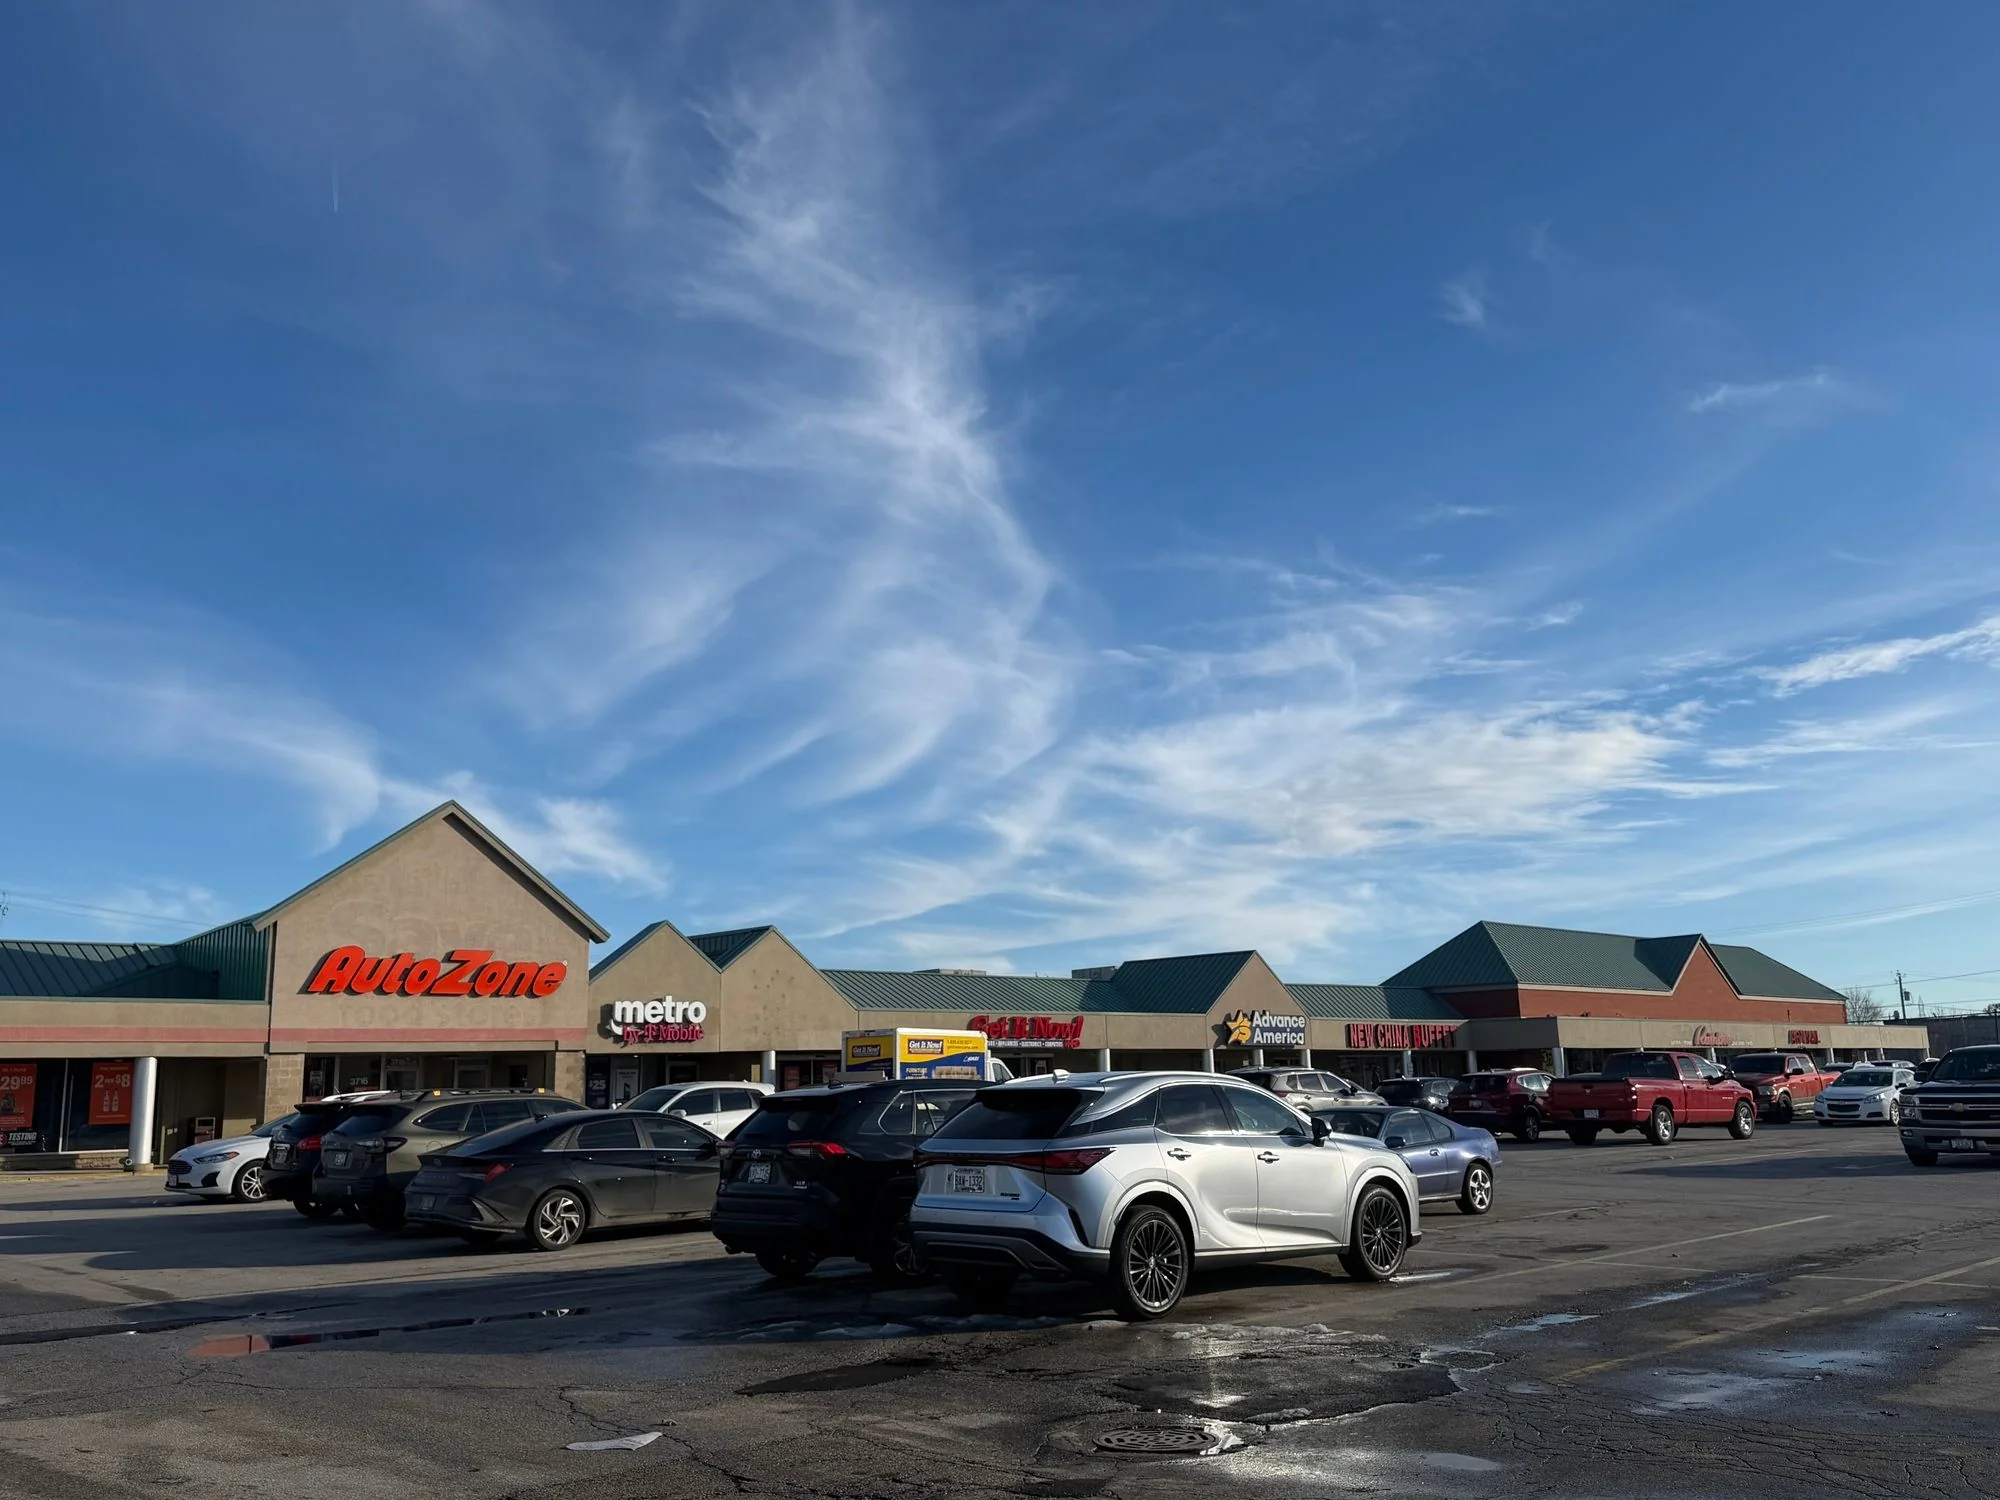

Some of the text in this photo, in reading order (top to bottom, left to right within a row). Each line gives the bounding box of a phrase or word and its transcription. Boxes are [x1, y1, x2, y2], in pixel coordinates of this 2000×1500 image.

[307, 945, 567, 996] AutoZone
[614, 995, 706, 1023] metro
[1252, 1011, 1305, 1028] Advance
[970, 1015, 1084, 1048] Get It Now!
[1253, 1028, 1305, 1045] America
[1349, 1023, 1457, 1048] NEW CHINA BUFFET
[909, 1040, 921, 1049] Get
[927, 1040, 943, 1051] Now!
[95, 1074, 104, 1088] 2
[9, 1131, 37, 1141] TESTING
